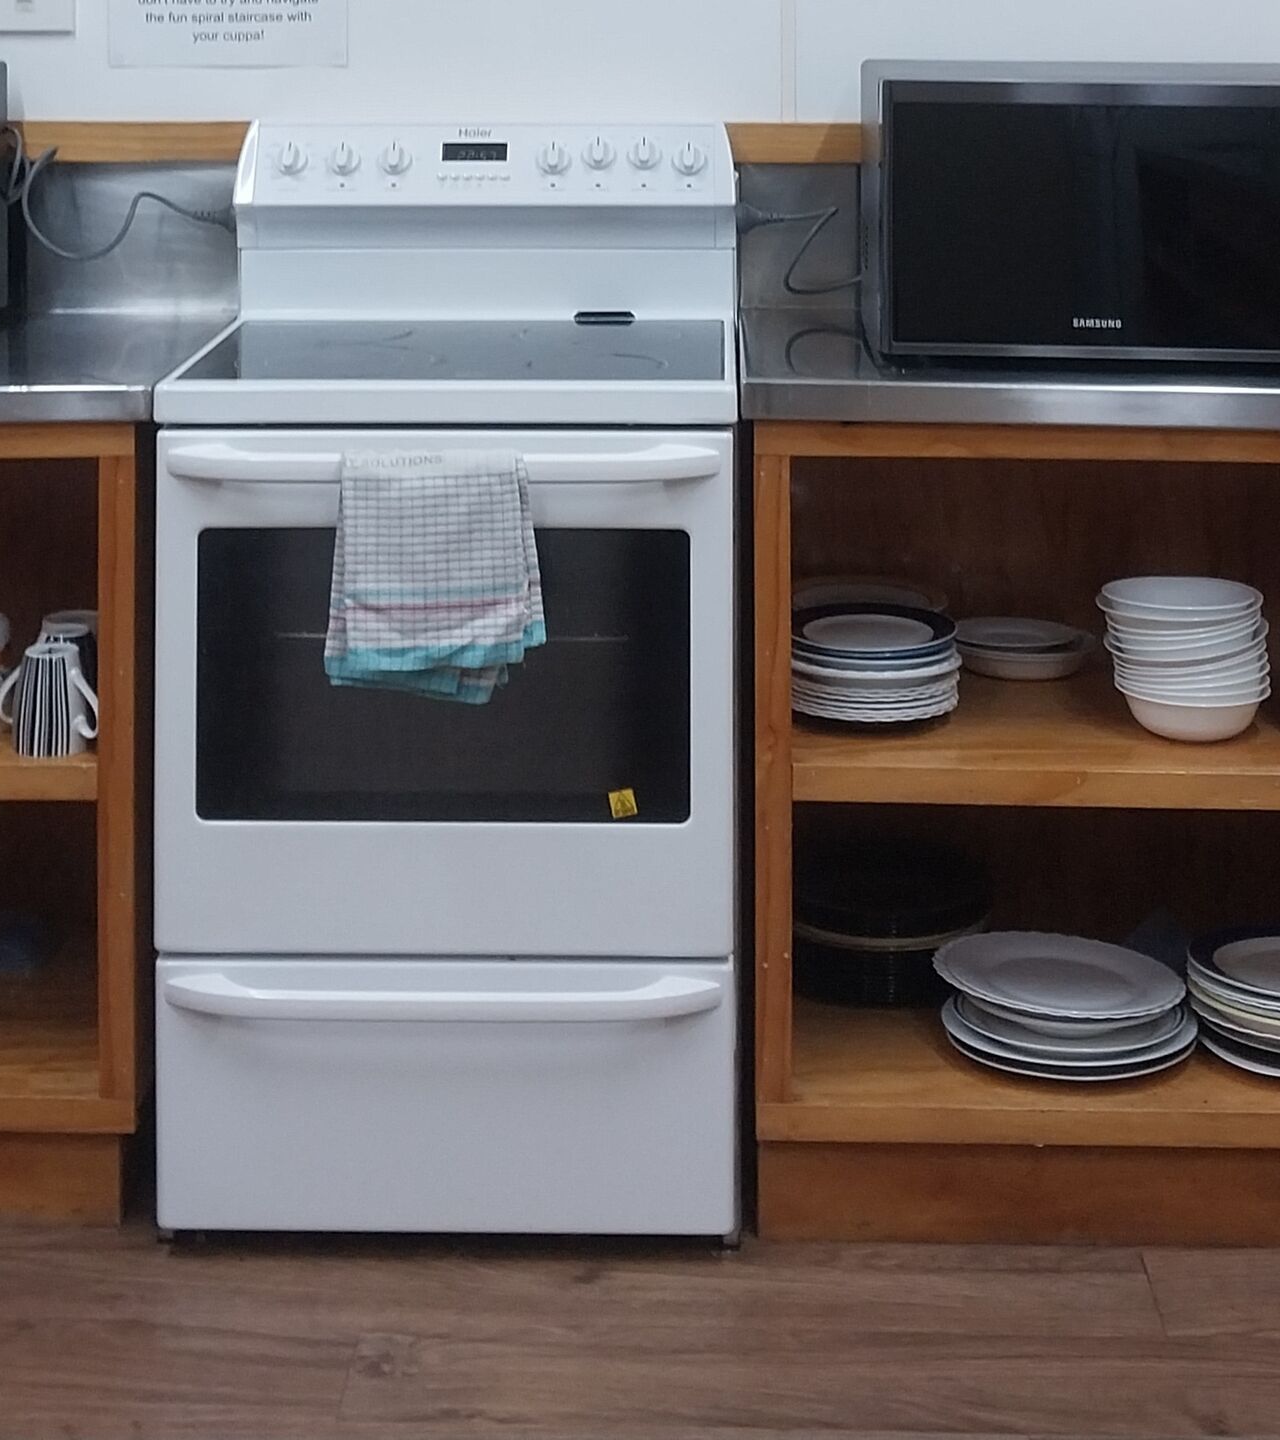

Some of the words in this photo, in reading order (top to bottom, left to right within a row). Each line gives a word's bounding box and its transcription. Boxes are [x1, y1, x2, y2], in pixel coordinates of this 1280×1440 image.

[145, 11, 164, 23] the
[169, 12, 188, 24] fun
[192, 11, 224, 25] spiral
[228, 12, 283, 24] staircase
[287, 11, 312, 23] with
[193, 31, 218, 45] your
[223, 29, 265, 44] cuppa!
[458, 128, 492, 137] Haier
[1073, 318, 1122, 328] SAMSUNG
